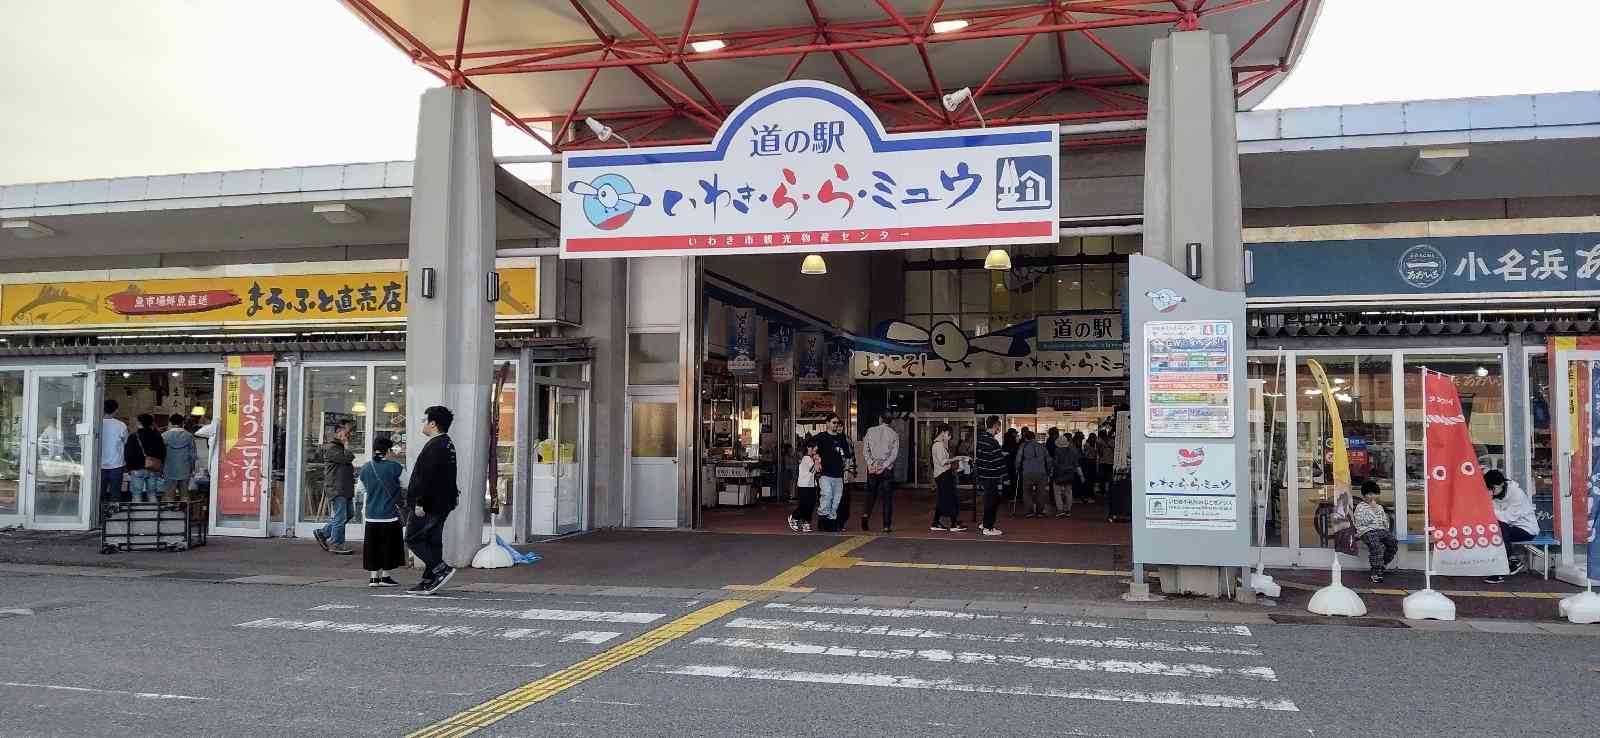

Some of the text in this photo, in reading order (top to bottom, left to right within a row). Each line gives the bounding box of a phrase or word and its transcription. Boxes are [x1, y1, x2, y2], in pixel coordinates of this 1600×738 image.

[749, 120, 846, 158] 道の駅
[688, 231, 911, 247] いわき市観光物産センター
[1052, 317, 1113, 340] 道の駅
[860, 353, 928, 377] ようこそ!
